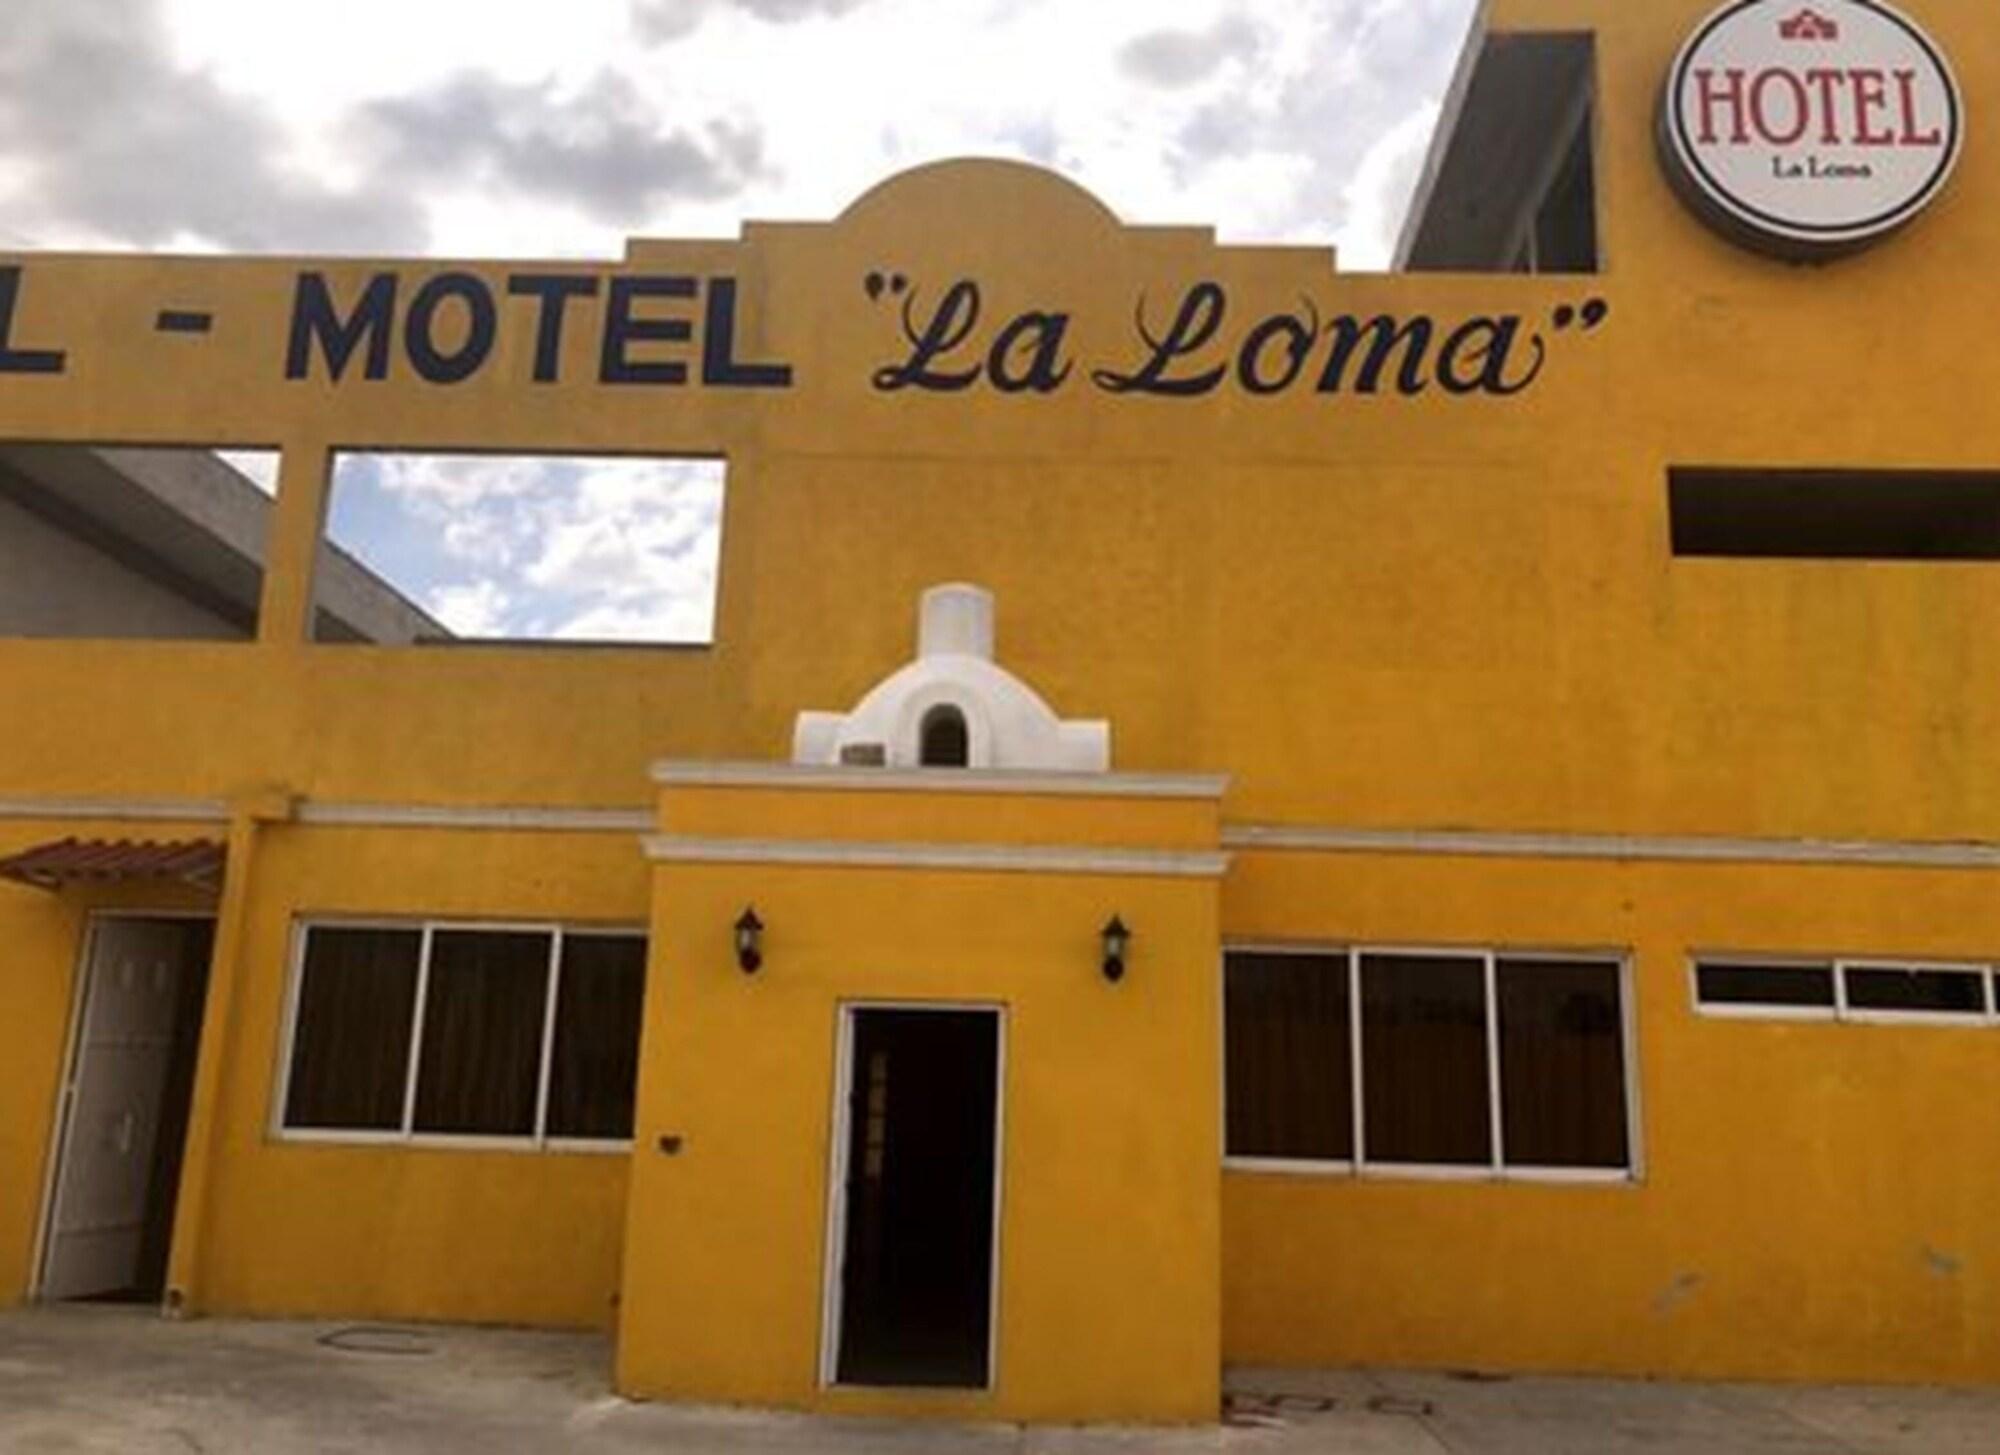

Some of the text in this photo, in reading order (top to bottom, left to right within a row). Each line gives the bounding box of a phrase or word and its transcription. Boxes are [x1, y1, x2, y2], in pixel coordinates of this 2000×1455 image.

[1693, 67, 1942, 146] HOTEL
[1772, 155, 1873, 179] La Loma
[285, 271, 794, 387] MOTEL
